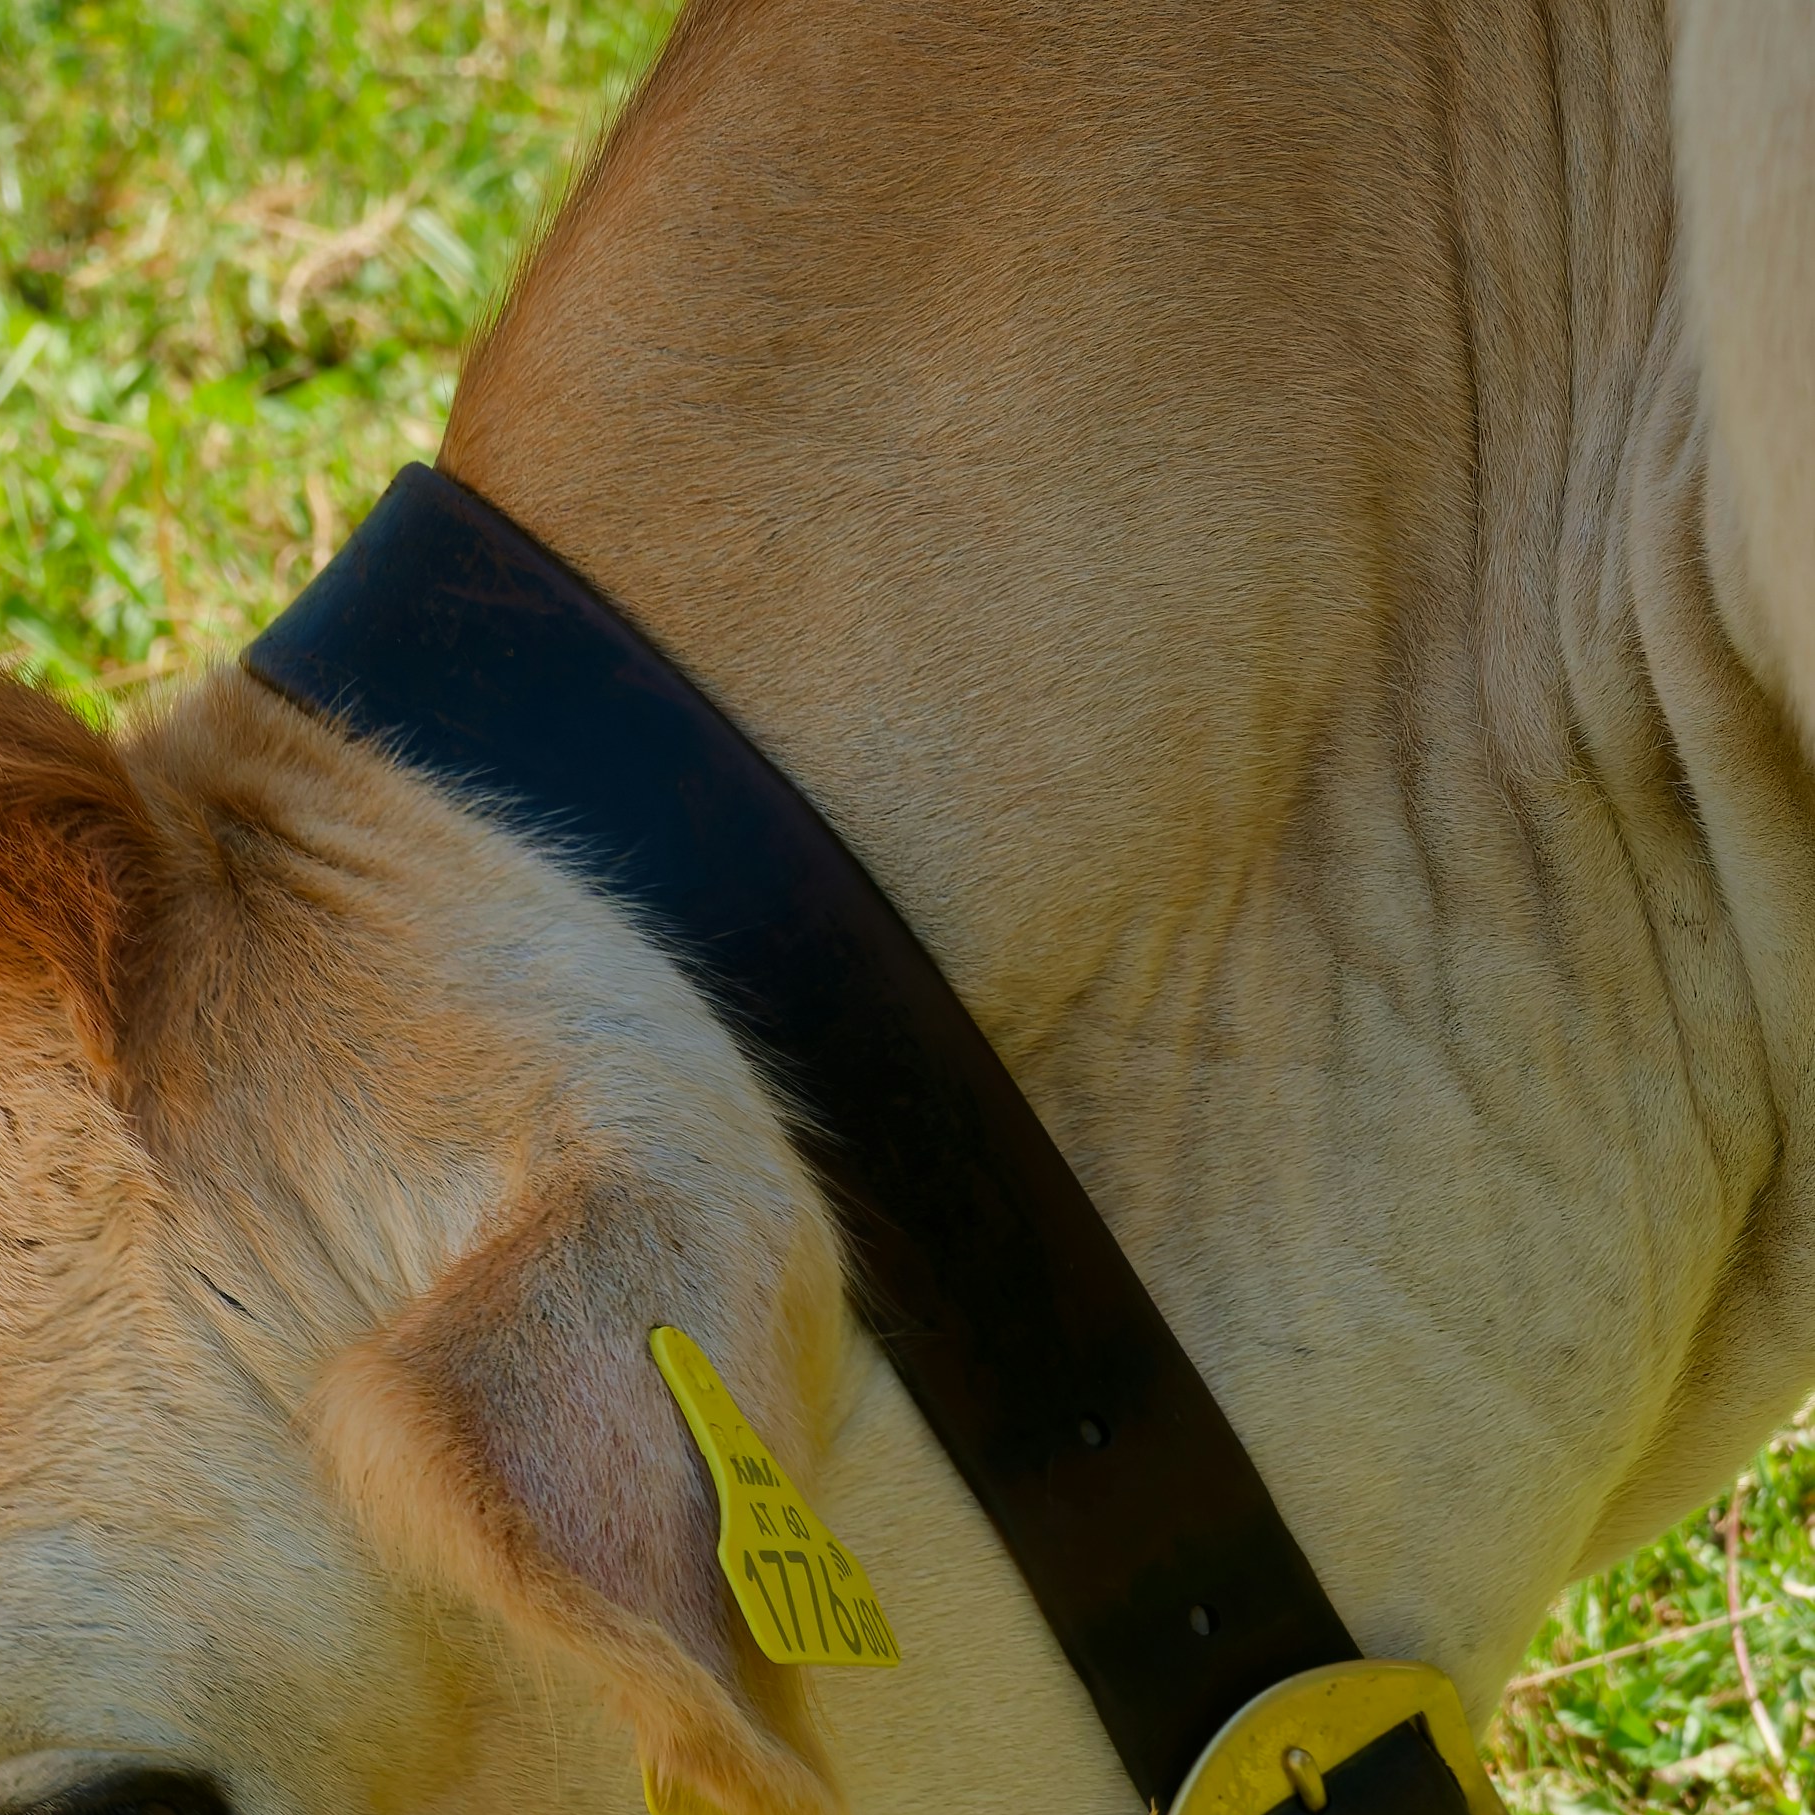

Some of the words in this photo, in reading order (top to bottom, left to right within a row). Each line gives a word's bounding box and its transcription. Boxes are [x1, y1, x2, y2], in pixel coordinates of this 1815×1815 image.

[749, 1502, 780, 1537] AT
[781, 1504, 811, 1541] 60
[743, 1549, 863, 1656] 1776
[852, 1597, 900, 1660] 601
